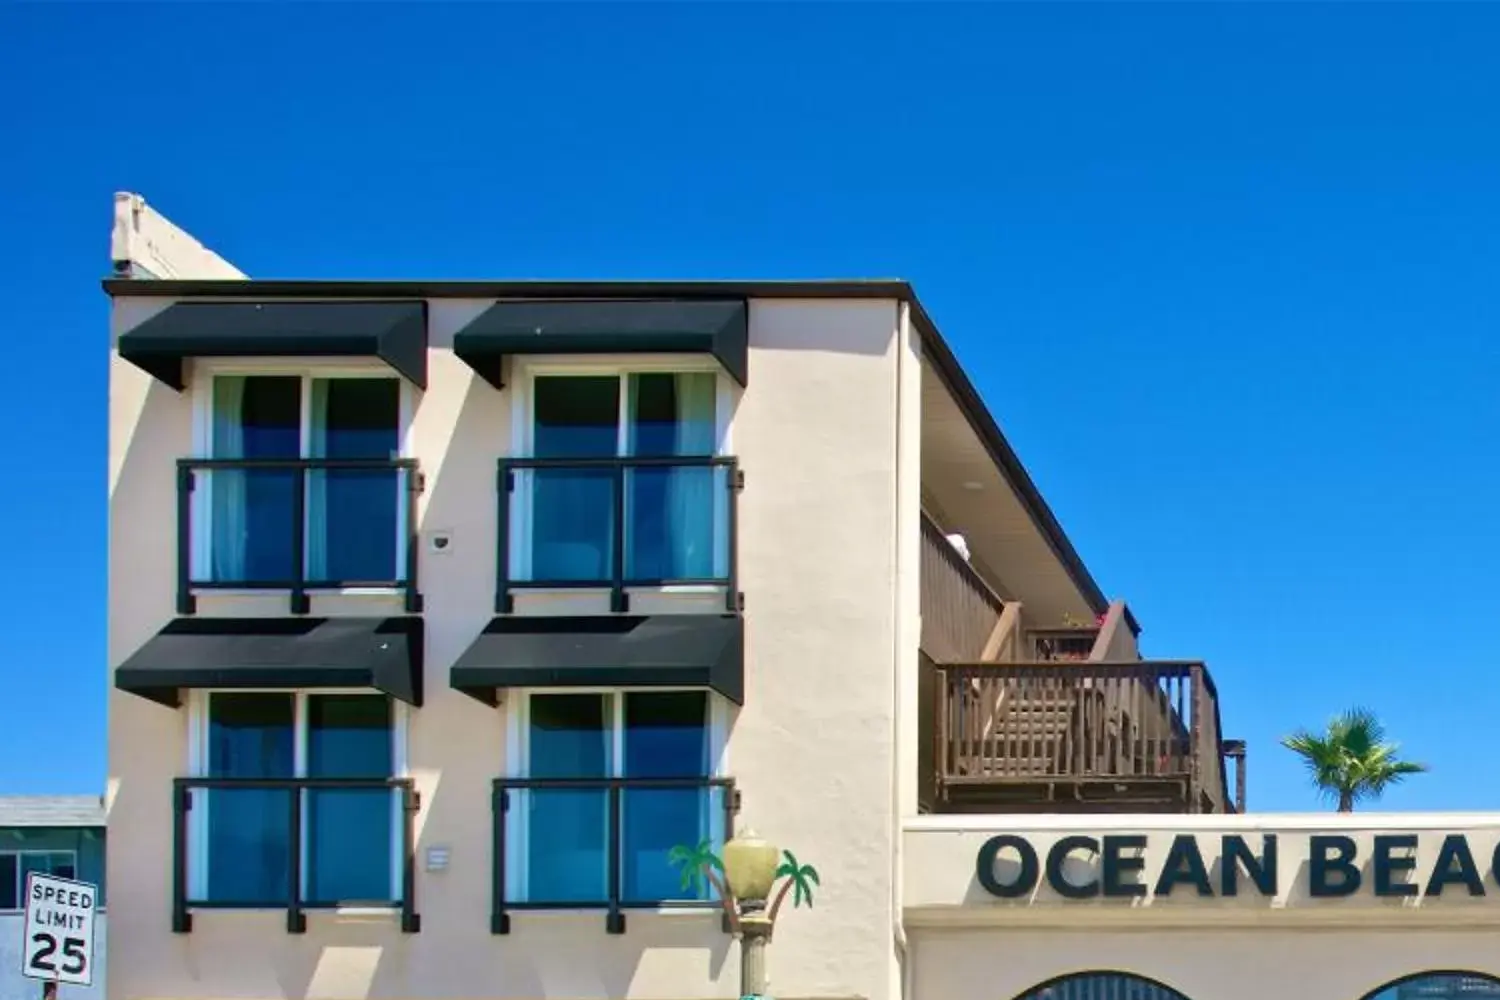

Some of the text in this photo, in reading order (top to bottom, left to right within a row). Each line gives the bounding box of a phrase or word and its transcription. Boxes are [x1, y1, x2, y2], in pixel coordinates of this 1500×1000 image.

[975, 834, 1278, 898] OCEAN
[33, 884, 92, 909] SPEED
[35, 908, 85, 929] LIMIT
[30, 933, 87, 975] 25
